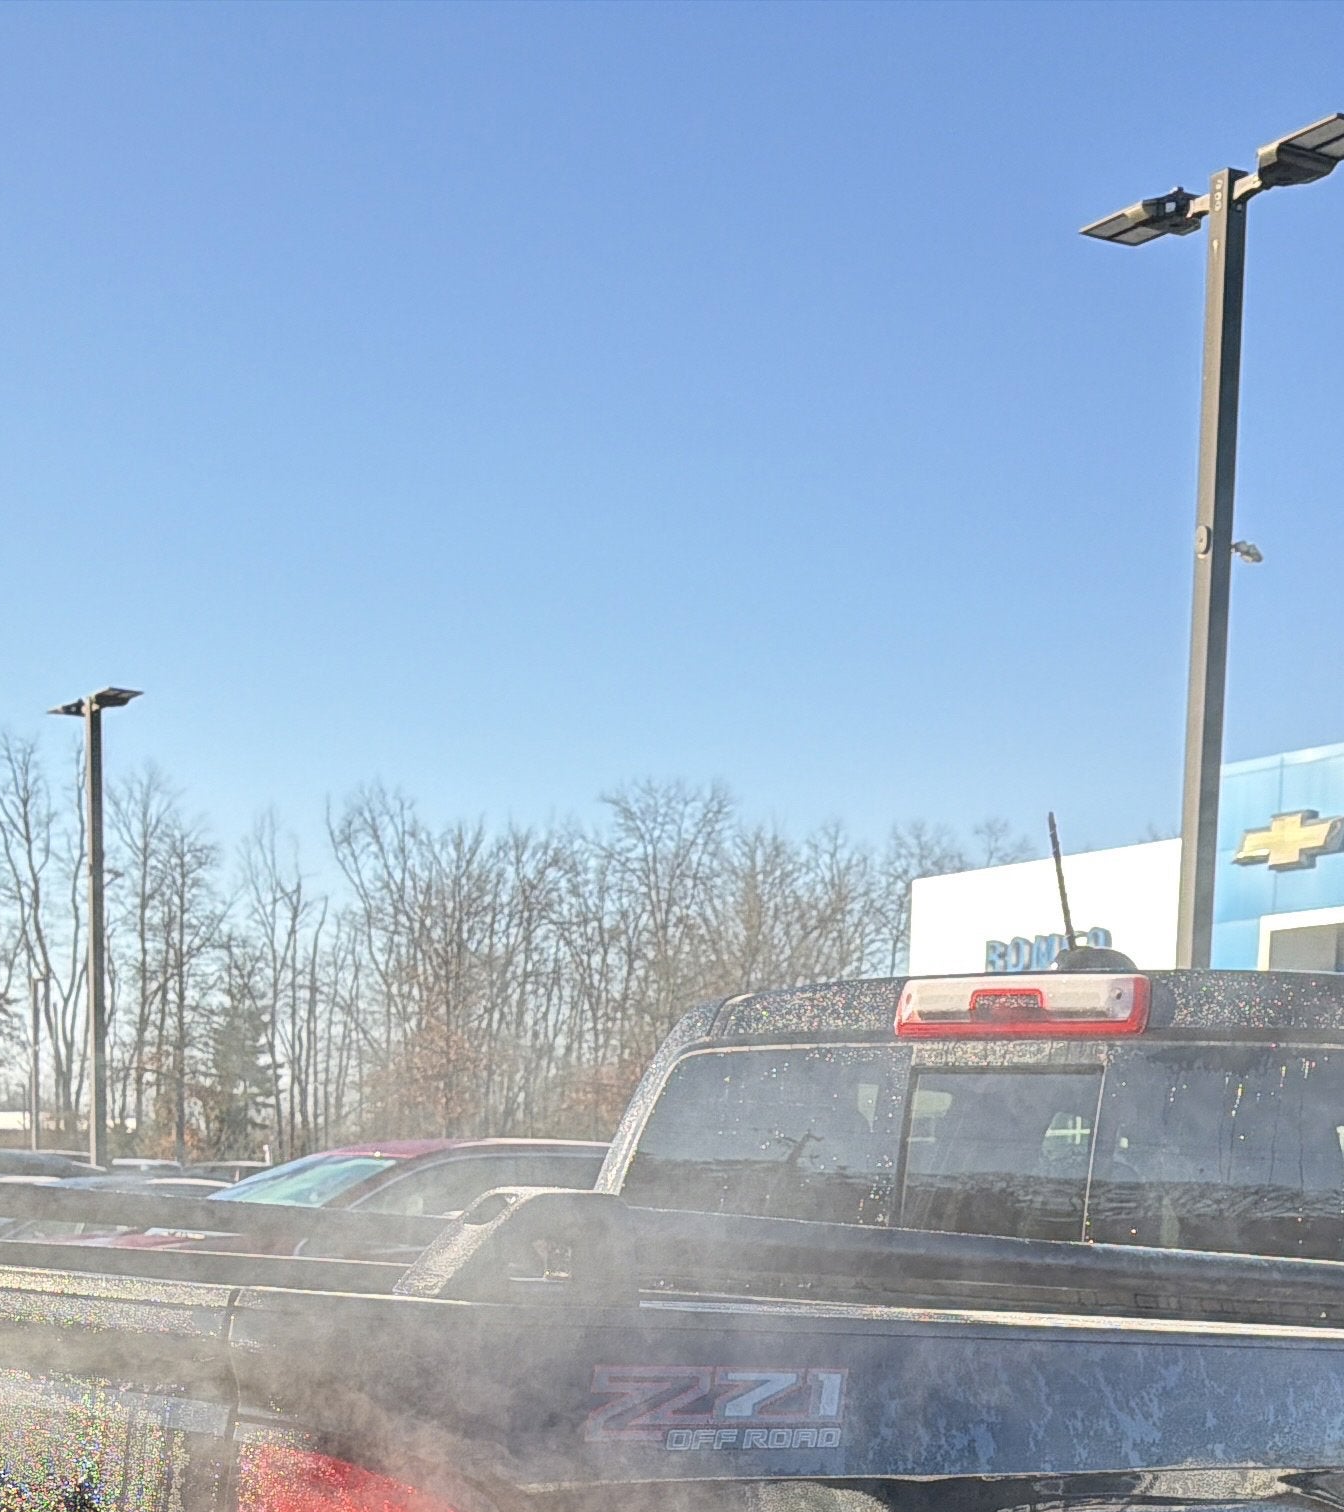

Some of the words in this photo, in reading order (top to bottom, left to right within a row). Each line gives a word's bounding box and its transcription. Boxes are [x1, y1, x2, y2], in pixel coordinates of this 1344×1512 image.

[584, 1365, 849, 1442] Z71
[665, 1428, 738, 1450] OFF
[741, 1428, 842, 1449] ROAD
